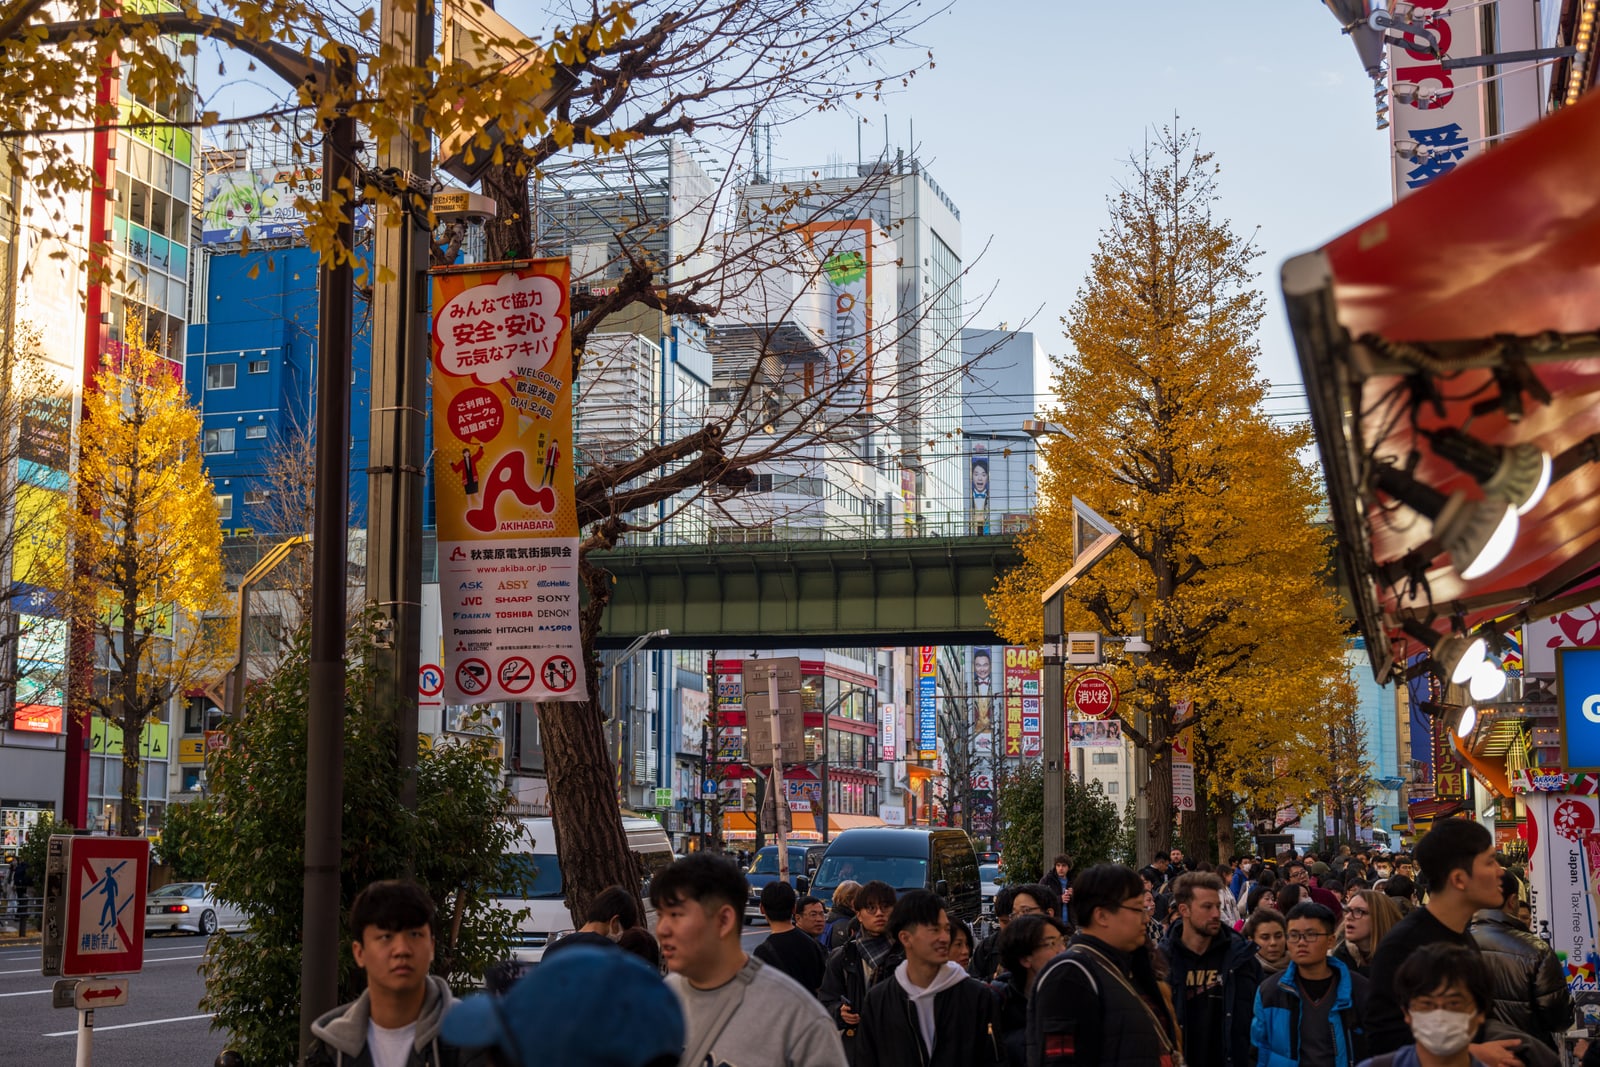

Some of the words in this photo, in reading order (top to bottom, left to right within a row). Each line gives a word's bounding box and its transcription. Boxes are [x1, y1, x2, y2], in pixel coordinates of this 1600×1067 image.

[450, 290, 542, 318] みんなで協力
[452, 312, 546, 346] 安全・安心
[456, 336, 550, 368] 元気なアキバ
[516, 366, 562, 391] WELCOME
[516, 380, 556, 404] 歡迎光臨
[457, 397, 491, 412] ご利用は
[510, 397, 528, 410] 어서
[528, 402, 553, 420] 오세요
[458, 408, 496, 424] Aマークの
[500, 520, 554, 531] AKIHABARA
[471, 546, 571, 560] 秋葉原電気街振興会
[477, 565, 547, 574] www.akiba.or.jp
[459, 581, 483, 589] ASK
[498, 580, 528, 590] ASSY
[461, 597, 482, 606] JVC
[922, 646, 932, 673] DVD
[1024, 700, 1038, 708] 3階
[1078, 689, 1108, 704] 消火栓
[1007, 676, 1021, 754] 秋葉原最大
[1452, 775, 1459, 794] 2F
[1569, 850, 1578, 885] Japan.
[1571, 890, 1581, 932] Tax-free
[82, 933, 118, 950] 横断禁止
[1573, 935, 1584, 962] Shop
